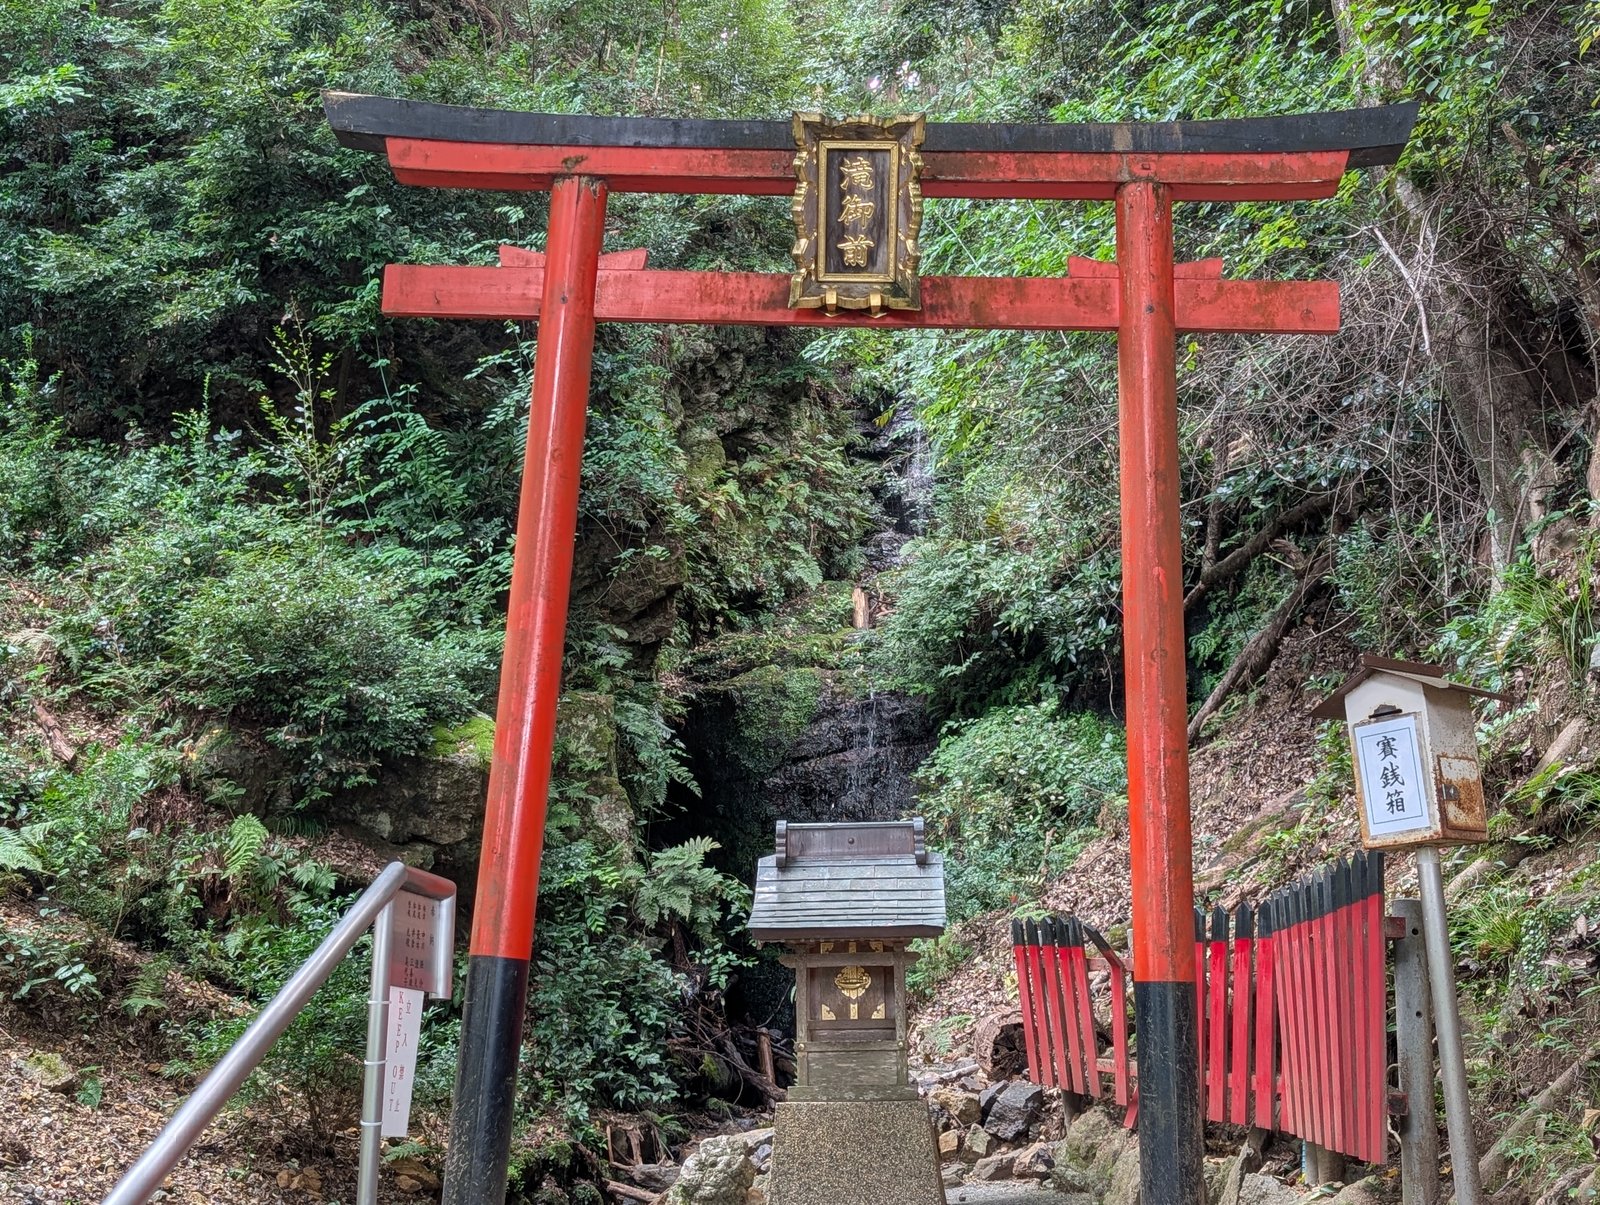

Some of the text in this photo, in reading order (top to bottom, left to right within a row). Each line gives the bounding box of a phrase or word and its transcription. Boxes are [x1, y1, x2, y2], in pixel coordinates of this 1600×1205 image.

[837, 156, 875, 268] 滝御前
[1376, 735, 1406, 815] 賽銭箱
[388, 991, 405, 1112] KEEP OUT
[393, 999, 412, 1113] 立入禁止
